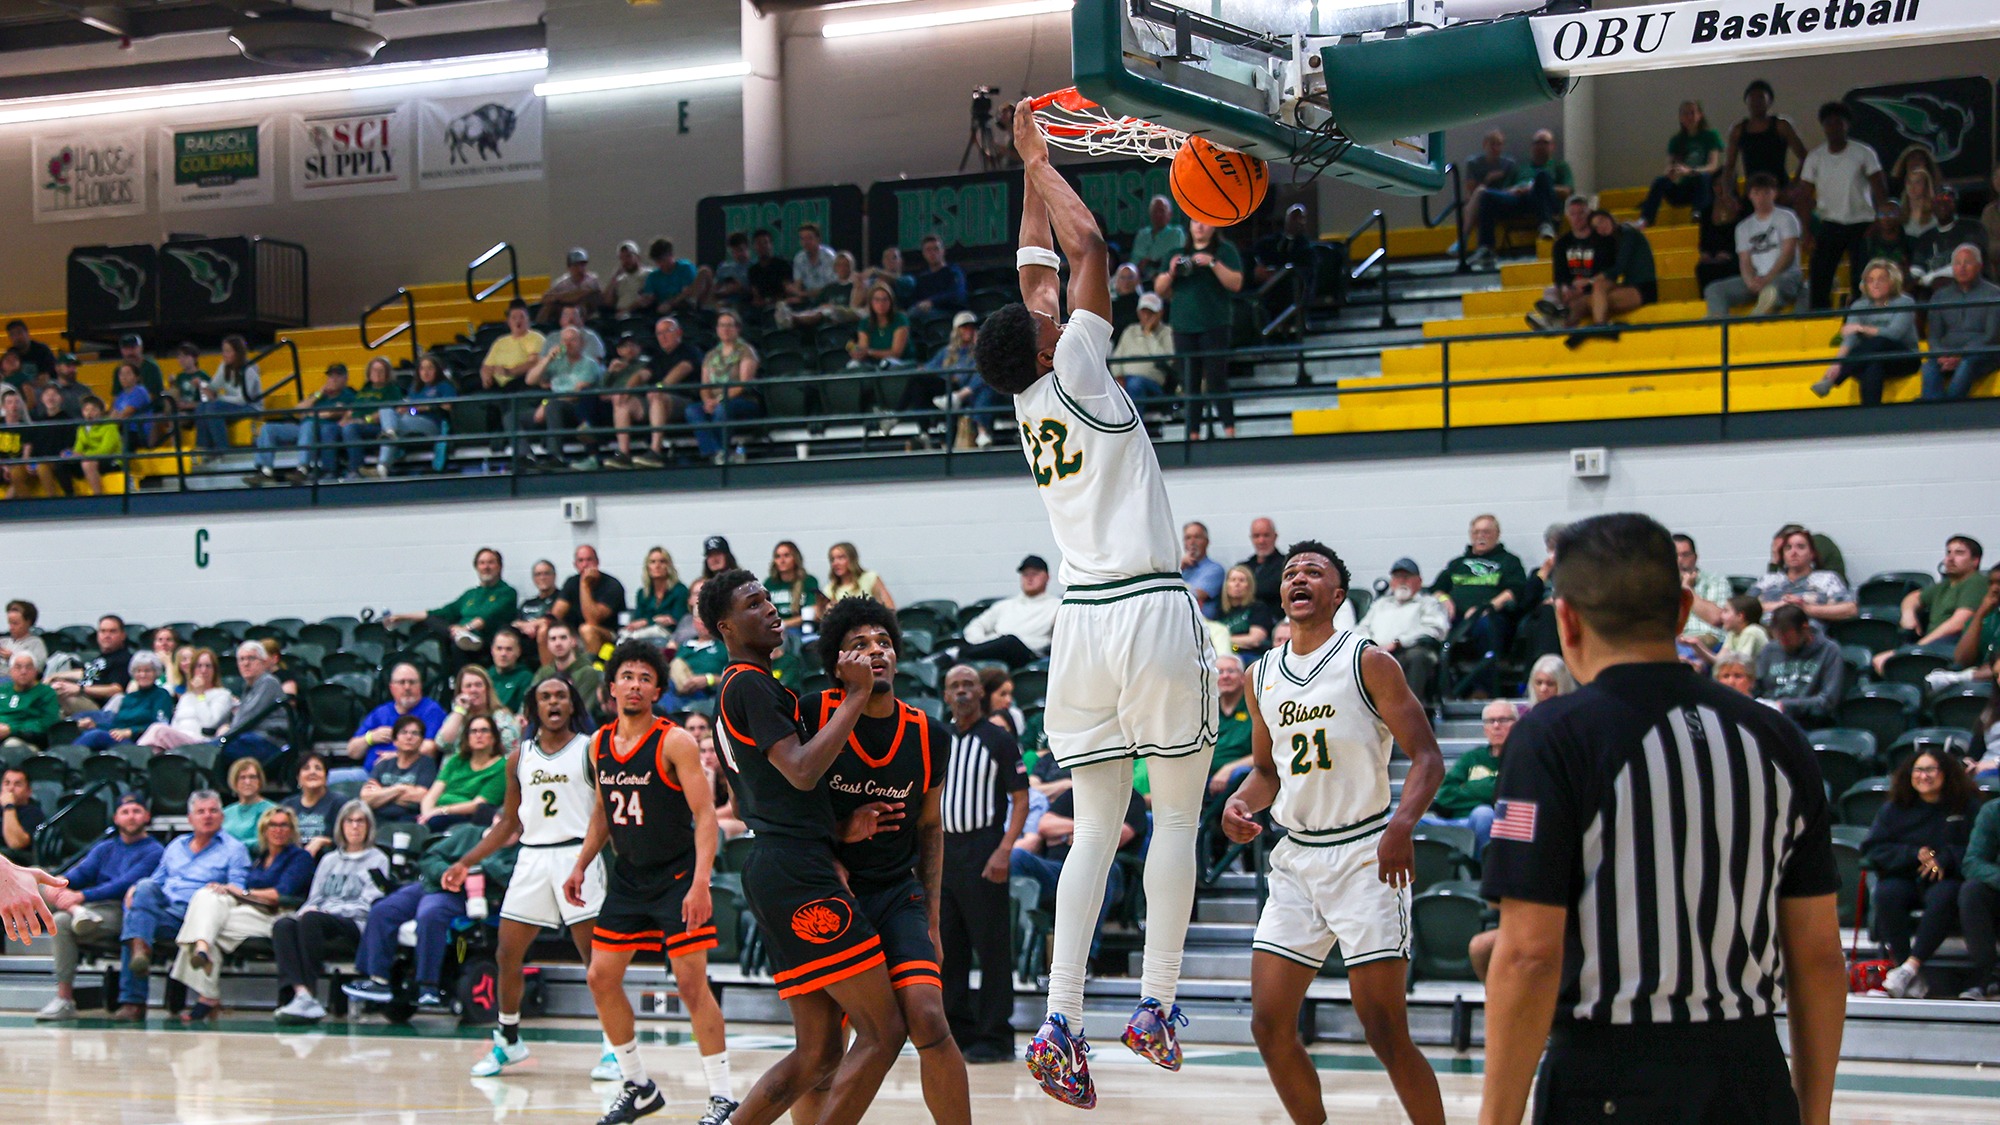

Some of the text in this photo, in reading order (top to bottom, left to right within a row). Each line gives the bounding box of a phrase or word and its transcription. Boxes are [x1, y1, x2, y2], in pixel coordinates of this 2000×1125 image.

[1552, 0, 1920, 61] OBU Basketball
[678, 101, 689, 134] E
[184, 132, 249, 153] RAUSCH
[333, 119, 388, 152] SCI
[180, 151, 256, 173] COLEMAN
[304, 150, 392, 180] SUPPLY
[894, 182, 1009, 250] BISON
[1021, 417, 1084, 488] 22
[195, 528, 209, 569] C
[1278, 700, 1336, 728] Bison
[1290, 727, 1333, 777] 21
[529, 769, 570, 786] Bison
[599, 769, 652, 787] East Central
[828, 774, 914, 799] East Central
[541, 789, 559, 819] 2
[609, 789, 645, 826] 24
